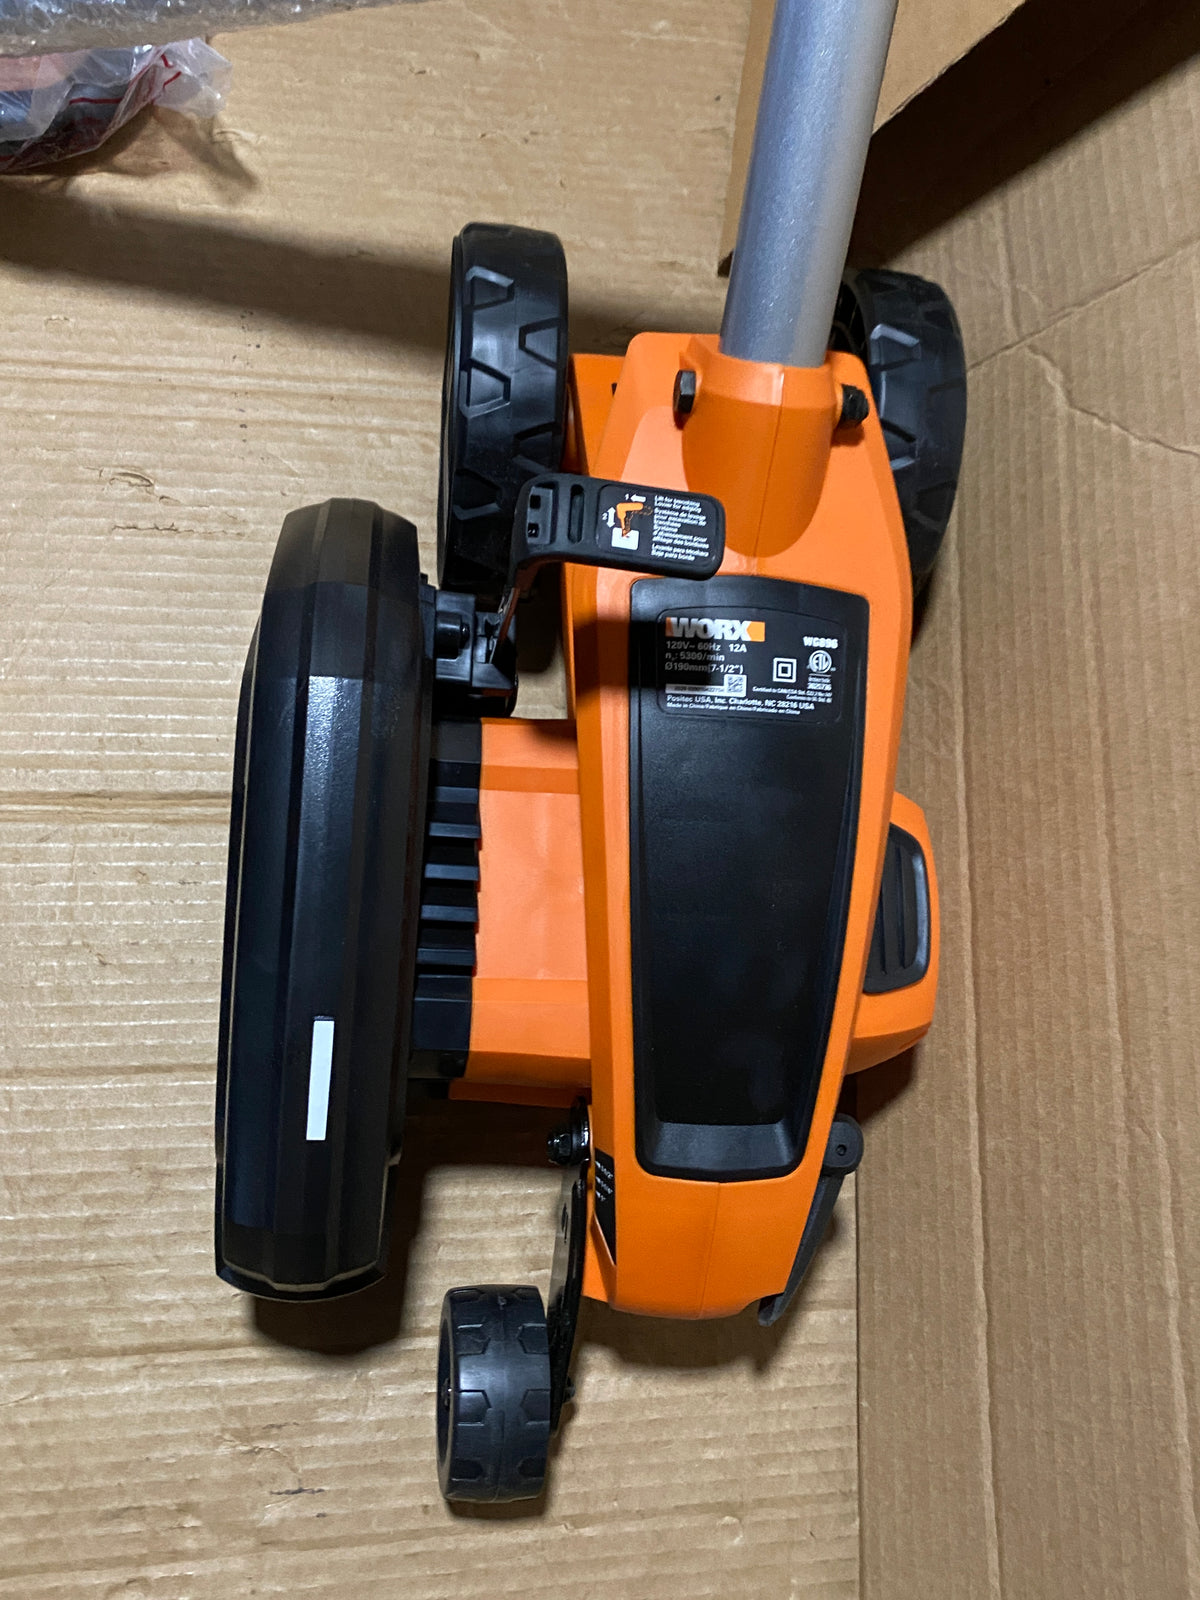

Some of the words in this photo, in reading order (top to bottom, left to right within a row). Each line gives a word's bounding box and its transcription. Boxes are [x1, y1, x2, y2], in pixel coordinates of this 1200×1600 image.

[602, 512, 608, 520] 2
[670, 617, 752, 641] WORX
[697, 642, 721, 651] 60Hz
[729, 643, 747, 653] 12A
[799, 702, 815, 710] USA
